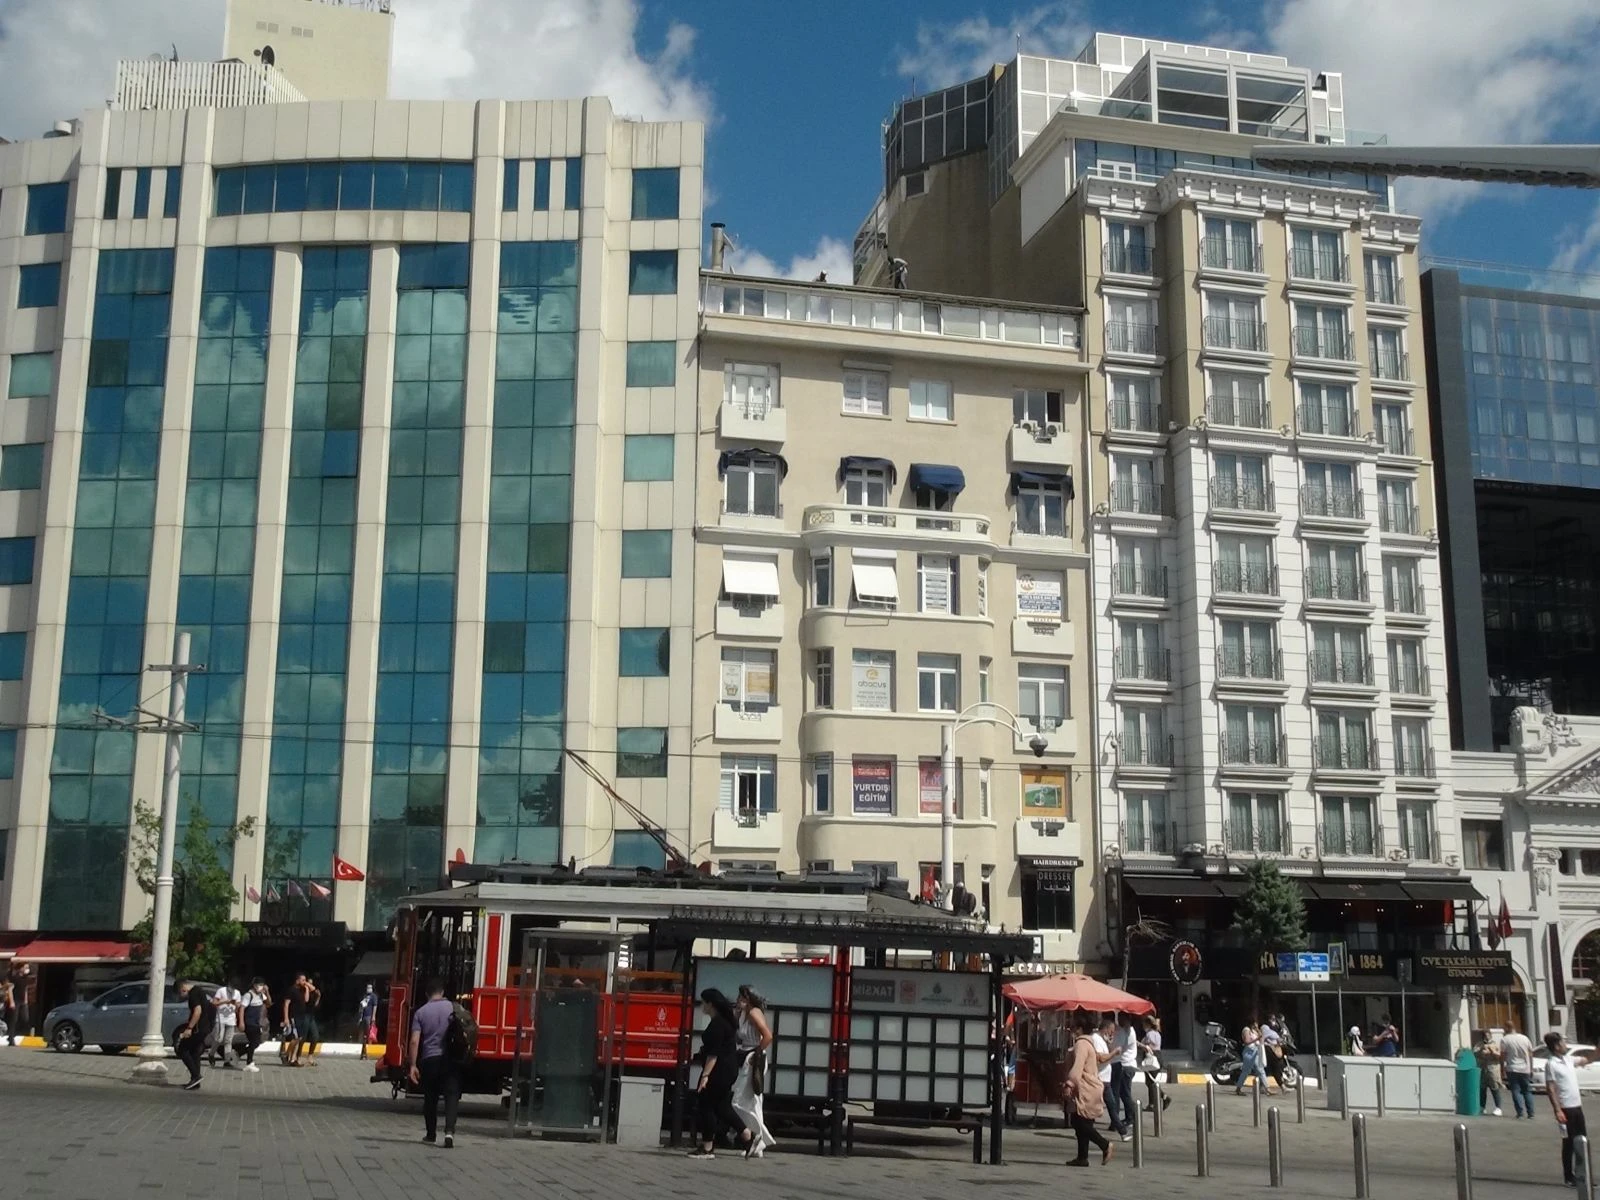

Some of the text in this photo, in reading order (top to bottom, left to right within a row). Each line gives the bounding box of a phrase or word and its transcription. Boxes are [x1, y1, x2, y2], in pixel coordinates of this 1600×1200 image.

[858, 680, 887, 688] abacus
[859, 793, 887, 802] EĞİTİM
[276, 927, 321, 937] SQUARE
[1360, 954, 1383, 969] 1864
[1477, 957, 1508, 966] HOTEL
